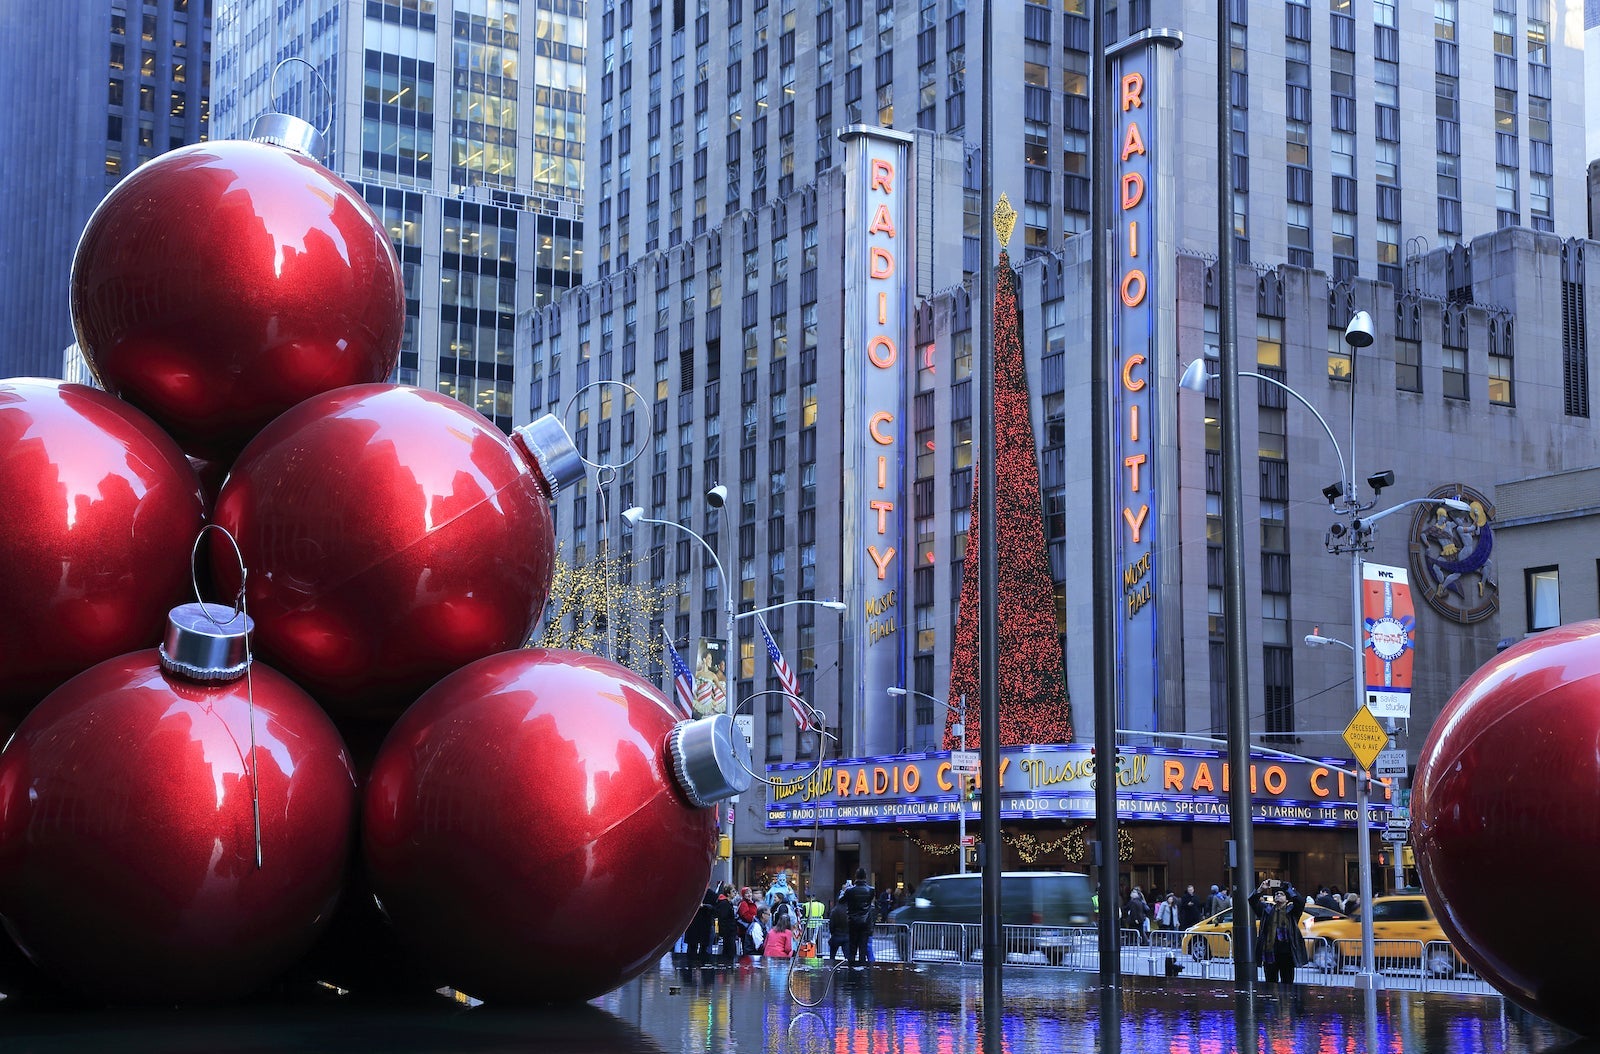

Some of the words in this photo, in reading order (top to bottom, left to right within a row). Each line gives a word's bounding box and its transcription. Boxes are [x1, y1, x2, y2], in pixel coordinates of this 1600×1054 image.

[1121, 72, 1146, 307] RADIO
[868, 158, 897, 369] RADIO
[1123, 353, 1148, 543] CITY
[867, 411, 896, 580] CITY
[1378, 570, 1394, 579] NYC
[707, 642, 719, 650] NYC
[1350, 733, 1381, 741] CROSSWALK
[1352, 724, 1378, 732] RECESSED
[836, 764, 920, 797] RADIO
[1020, 759, 1096, 789] Music
[769, 811, 786, 820] CHASE
[792, 809, 814, 819] RADIO
[818, 808, 834, 818] CITY
[838, 805, 879, 818] CHRISTMAS
[883, 803, 939, 815] SPECTACULAR
[943, 802, 965, 813] FINA
[1011, 799, 1049, 810] RADIO
[1059, 799, 1092, 810] CITY
[1119, 800, 1167, 812] RISTMAS
[1261, 805, 1312, 819] STARRING
[1319, 808, 1337, 819] THE
